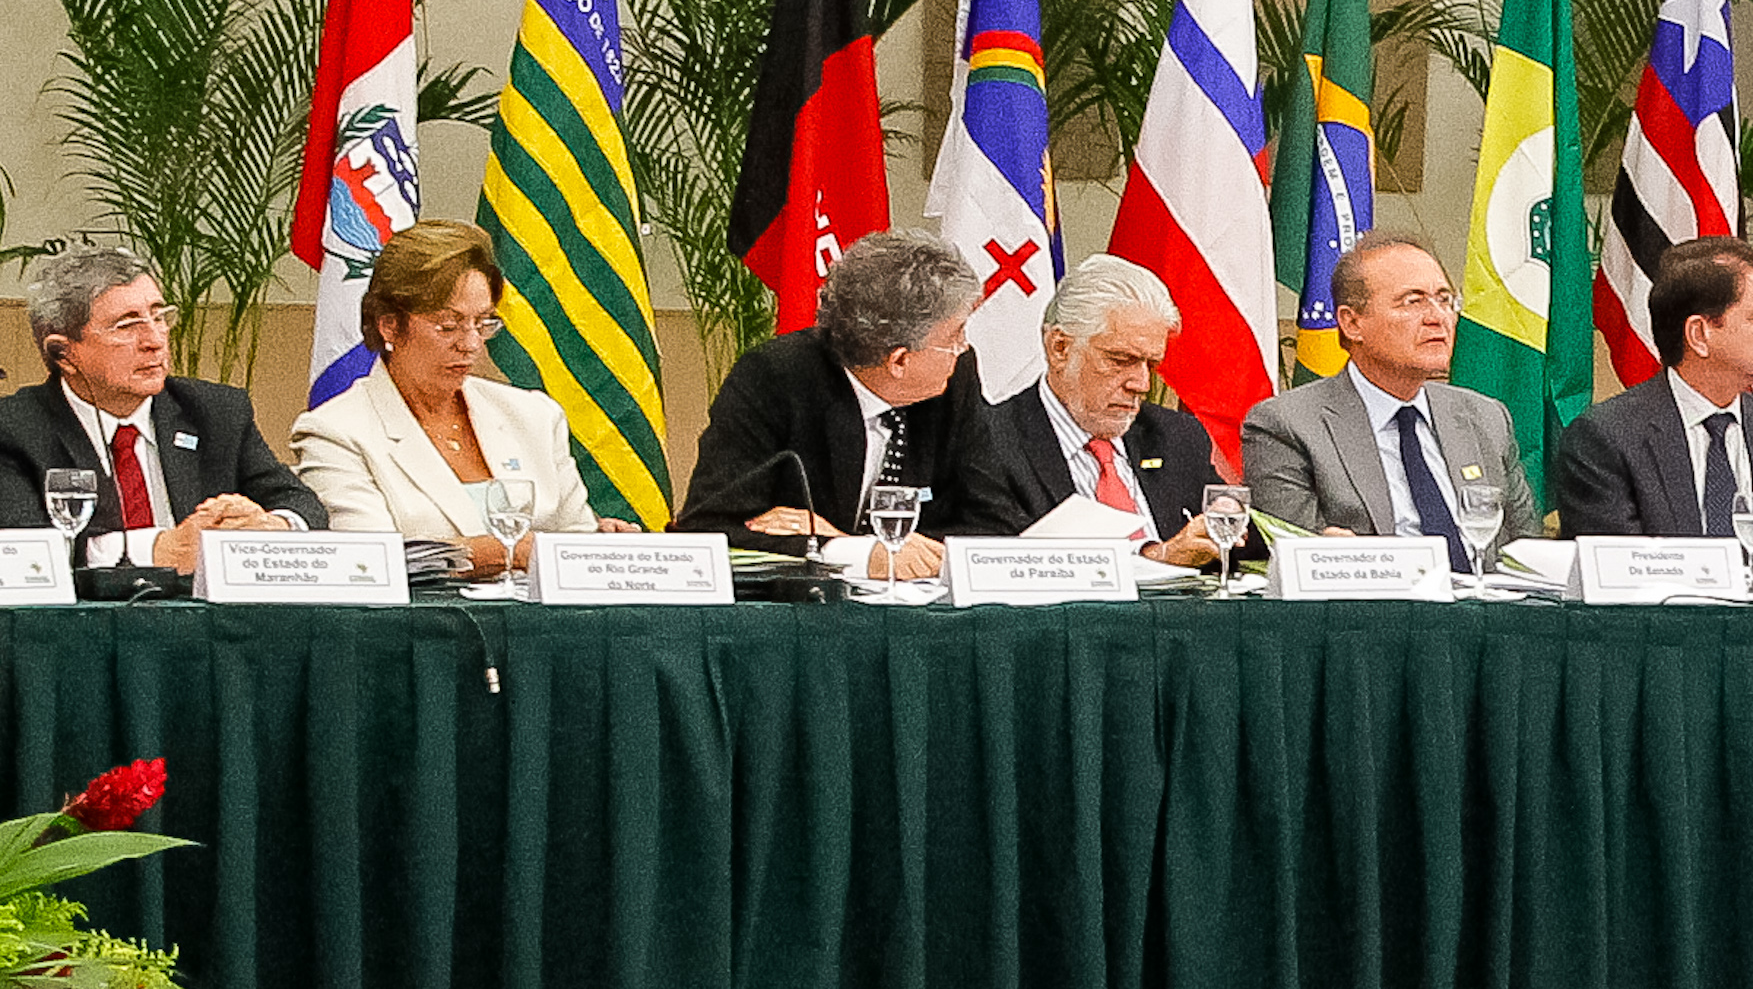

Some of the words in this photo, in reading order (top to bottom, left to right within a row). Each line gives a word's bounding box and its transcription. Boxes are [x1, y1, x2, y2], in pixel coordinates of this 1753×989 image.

[229, 543, 338, 555] Vice-Governador
[560, 551, 634, 561] Governadora
[637, 552, 652, 562] do
[655, 552, 694, 562] Estado
[971, 553, 1044, 565] Governador
[1048, 553, 1064, 565] do
[1067, 553, 1110, 565] Estado
[1311, 553, 1377, 563] Governador
[1380, 553, 1394, 563] do
[242, 558, 259, 569] do
[263, 558, 308, 569] Estado
[311, 558, 328, 569] do
[588, 564, 603, 574] do
[606, 564, 626, 574] Rio
[628, 564, 669, 575] Grande
[1010, 568, 1025, 578] da
[1311, 569, 1351, 580] Estado
[1370, 569, 1402, 579] Bahia
[255, 572, 319, 583] Maranhão
[625, 581, 656, 590] Norte
